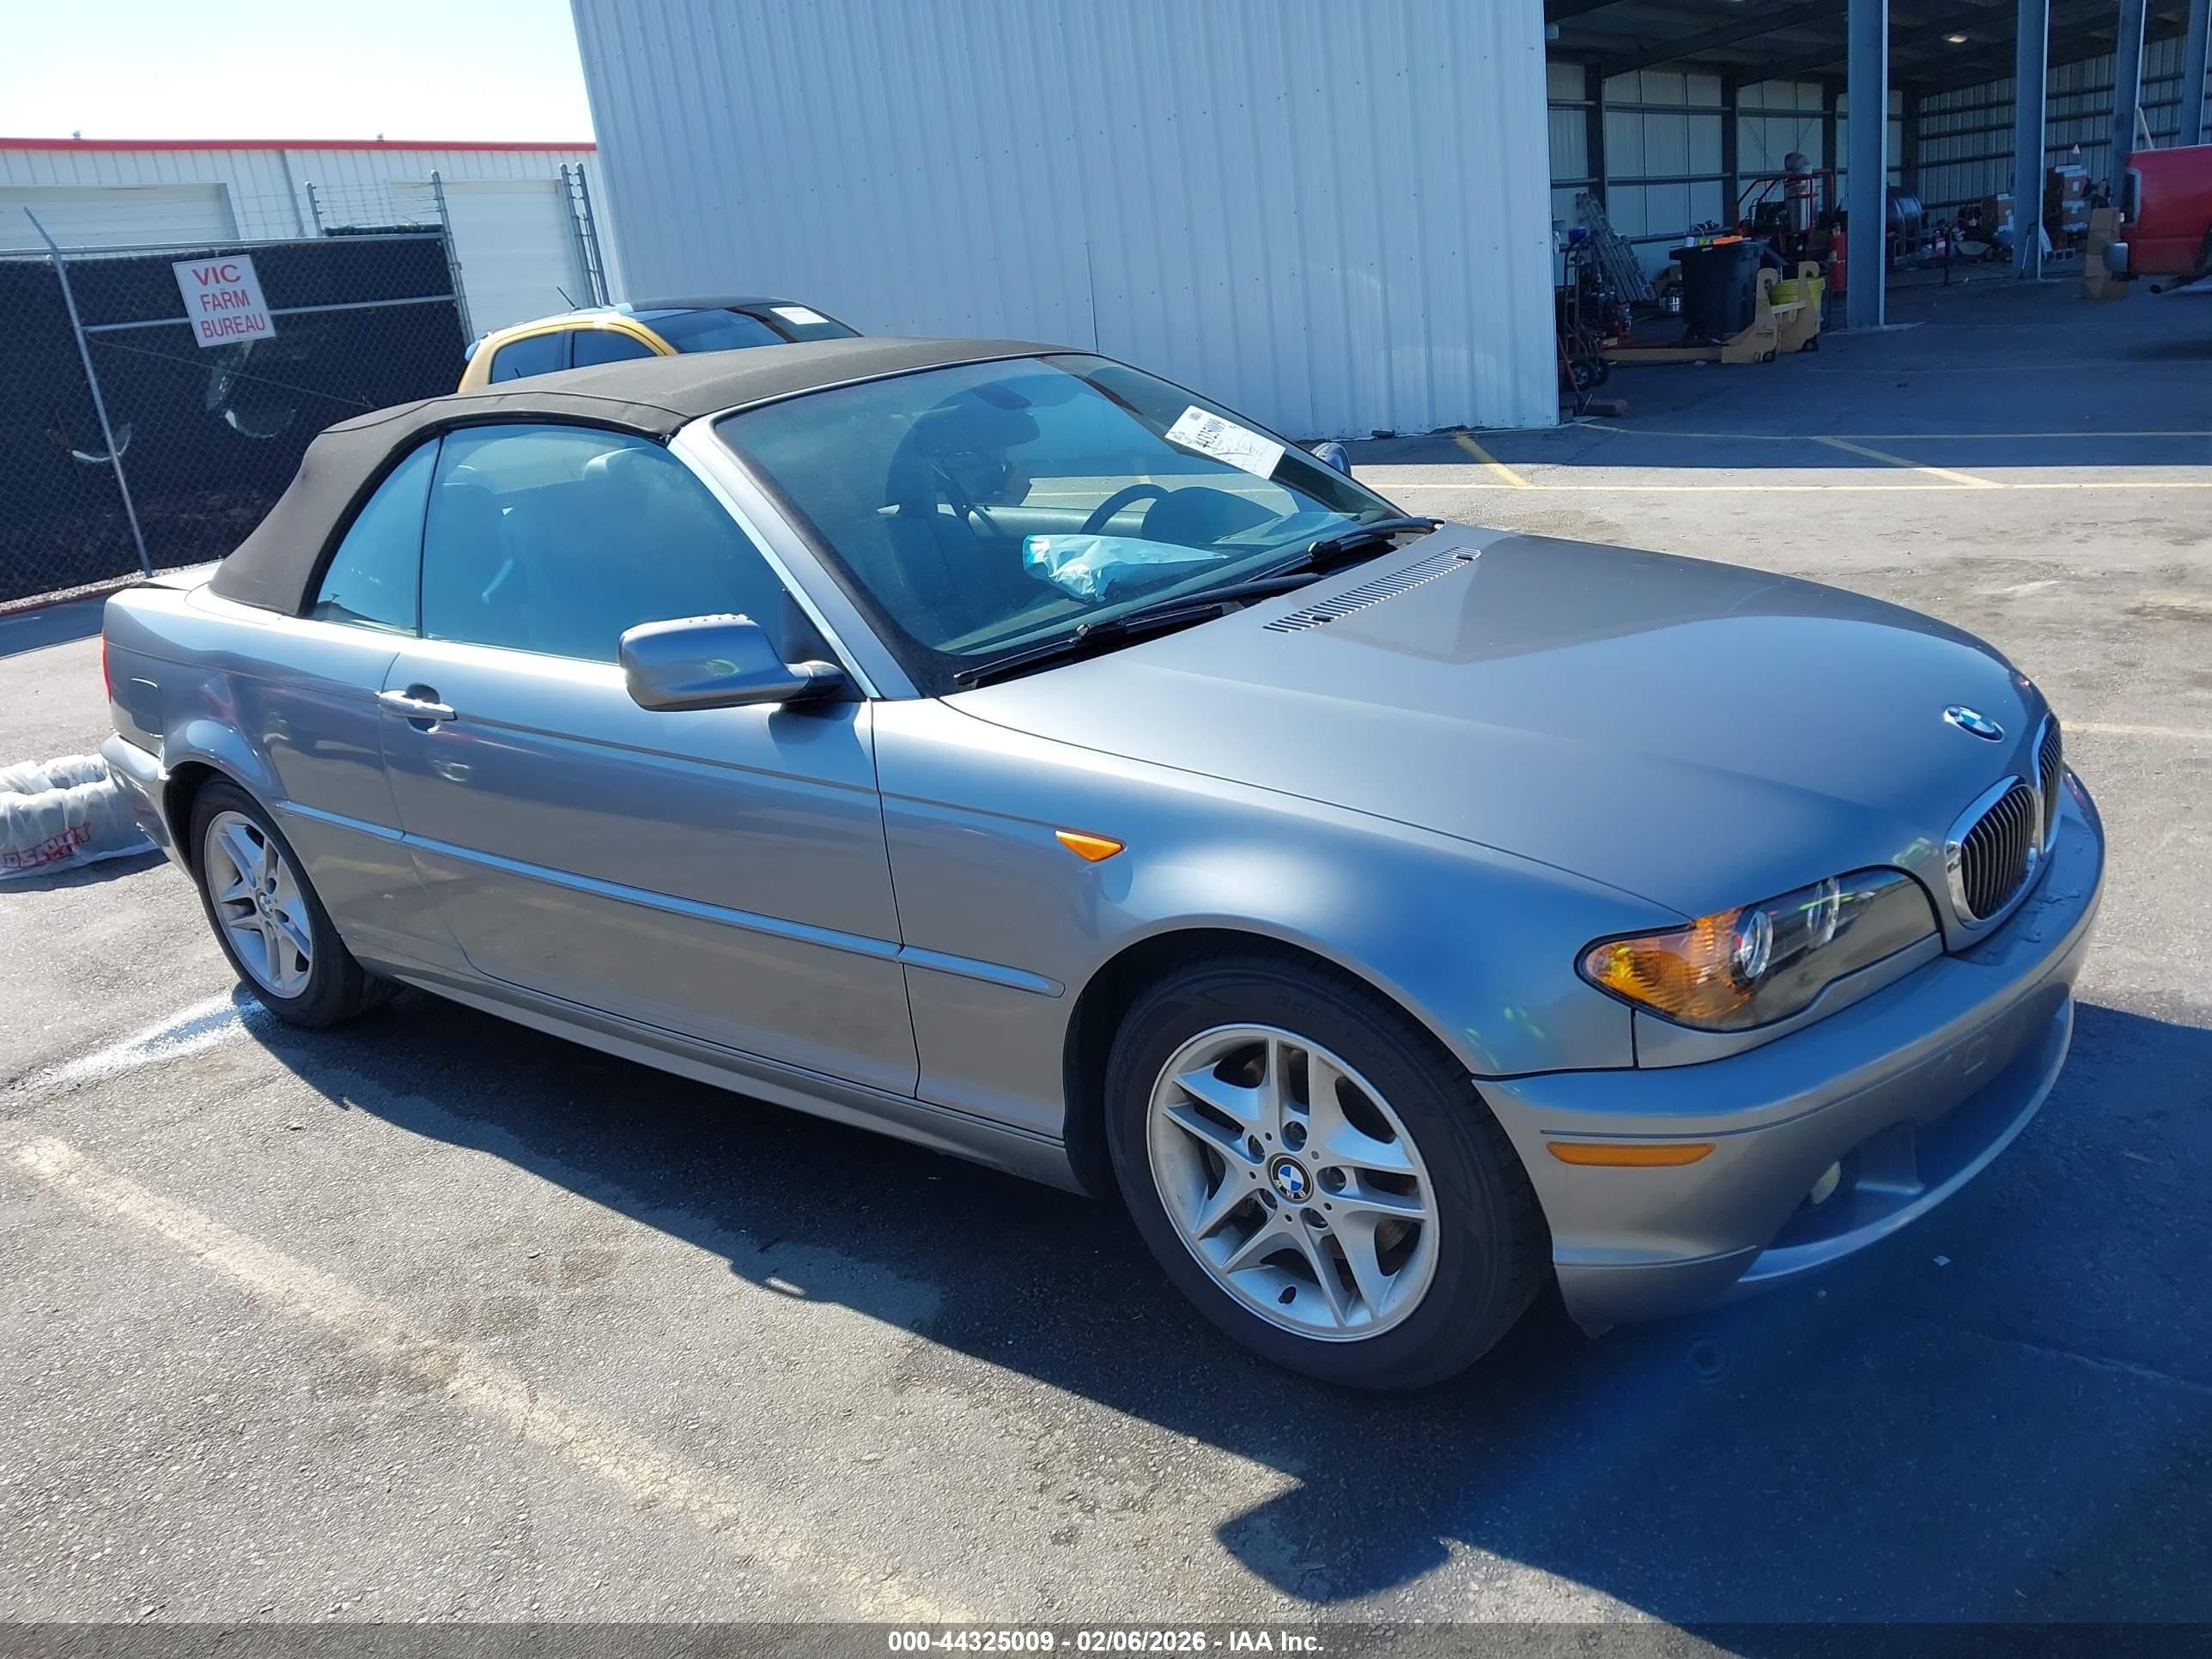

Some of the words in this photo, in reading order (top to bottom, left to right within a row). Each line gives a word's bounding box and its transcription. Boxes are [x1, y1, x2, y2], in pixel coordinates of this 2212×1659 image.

[191, 264, 241, 286] VIC
[199, 289, 251, 313] FARM
[200, 313, 266, 338] BUREAU
[1195, 417, 1227, 448] 44325009
